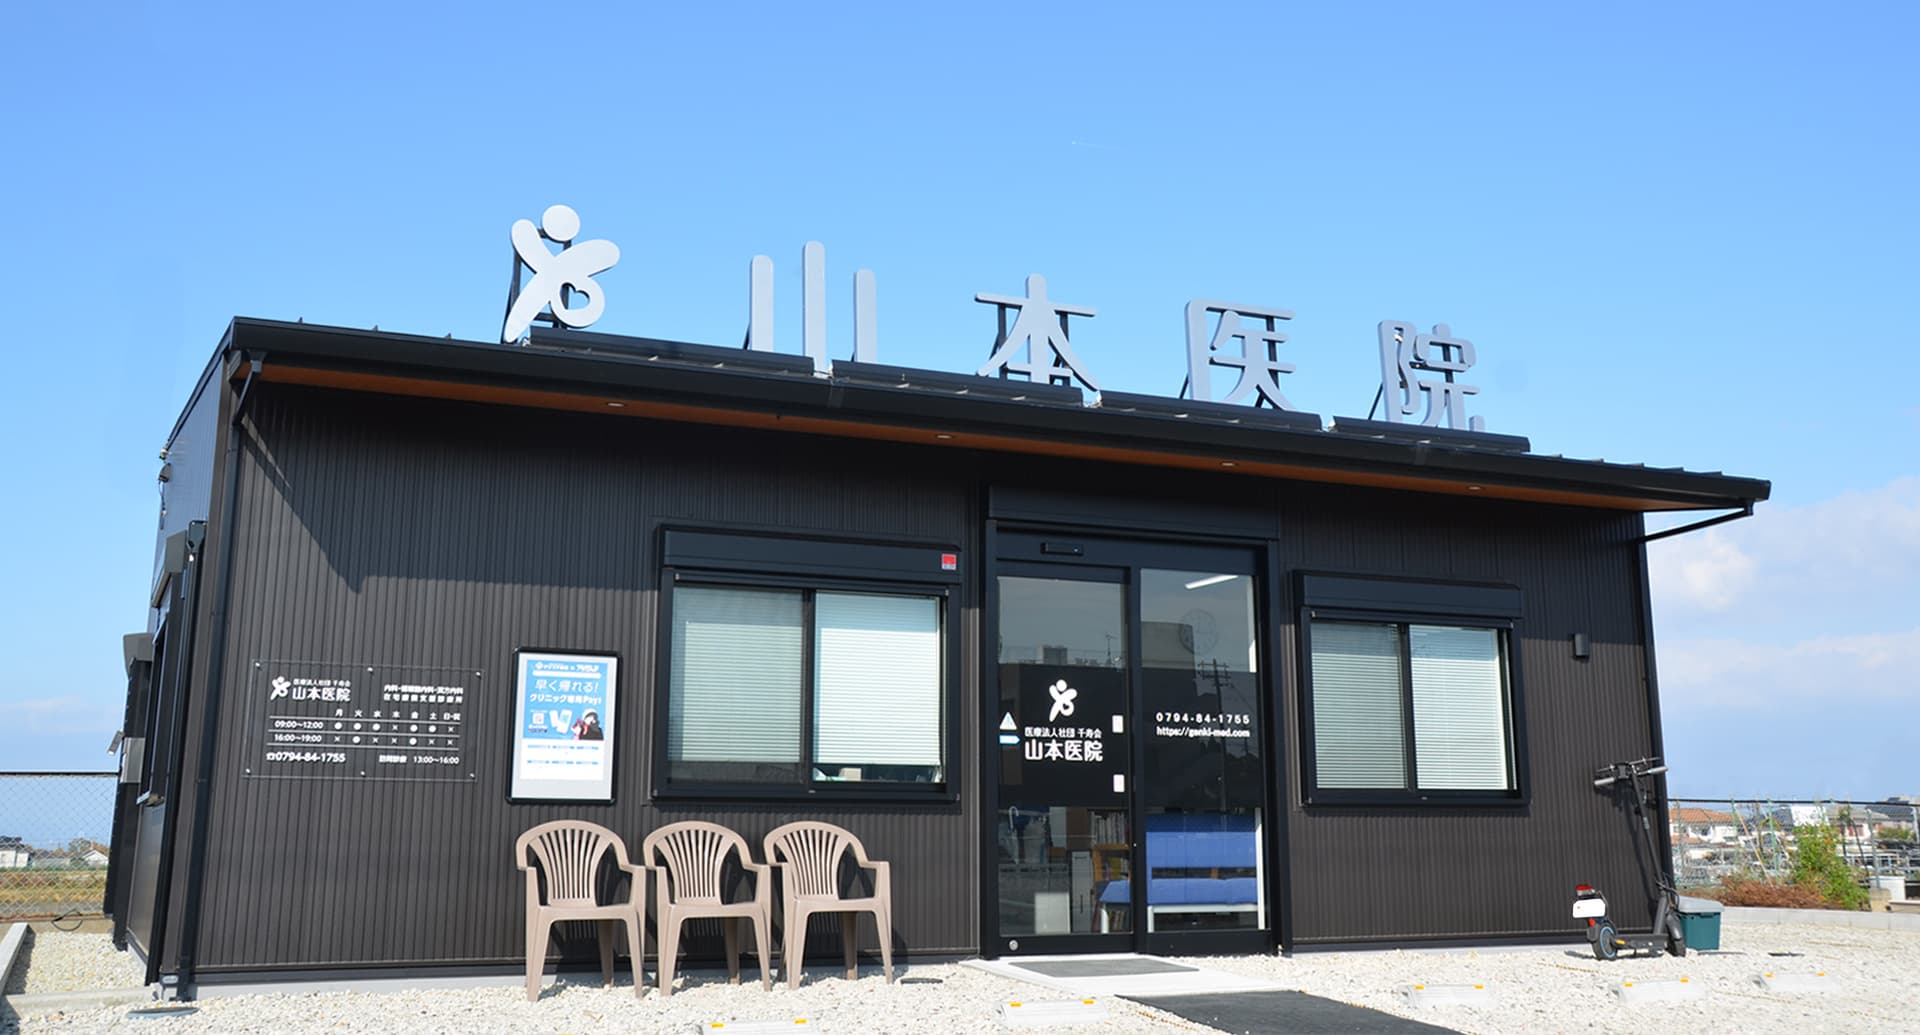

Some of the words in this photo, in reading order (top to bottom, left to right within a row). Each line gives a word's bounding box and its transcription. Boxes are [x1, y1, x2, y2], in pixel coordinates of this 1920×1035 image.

[749, 241, 1485, 433] 山本医院
[292, 686, 351, 702] 山本医院
[335, 708, 343, 717] 月
[354, 709, 362, 717] 火
[429, 712, 437, 720] 土
[1156, 712, 1250, 724] 0794-84-1755
[1024, 726, 1076, 738] 医療法人社団
[1077, 727, 1102, 739] 千寿会
[1024, 738, 1104, 762] 山本医院
